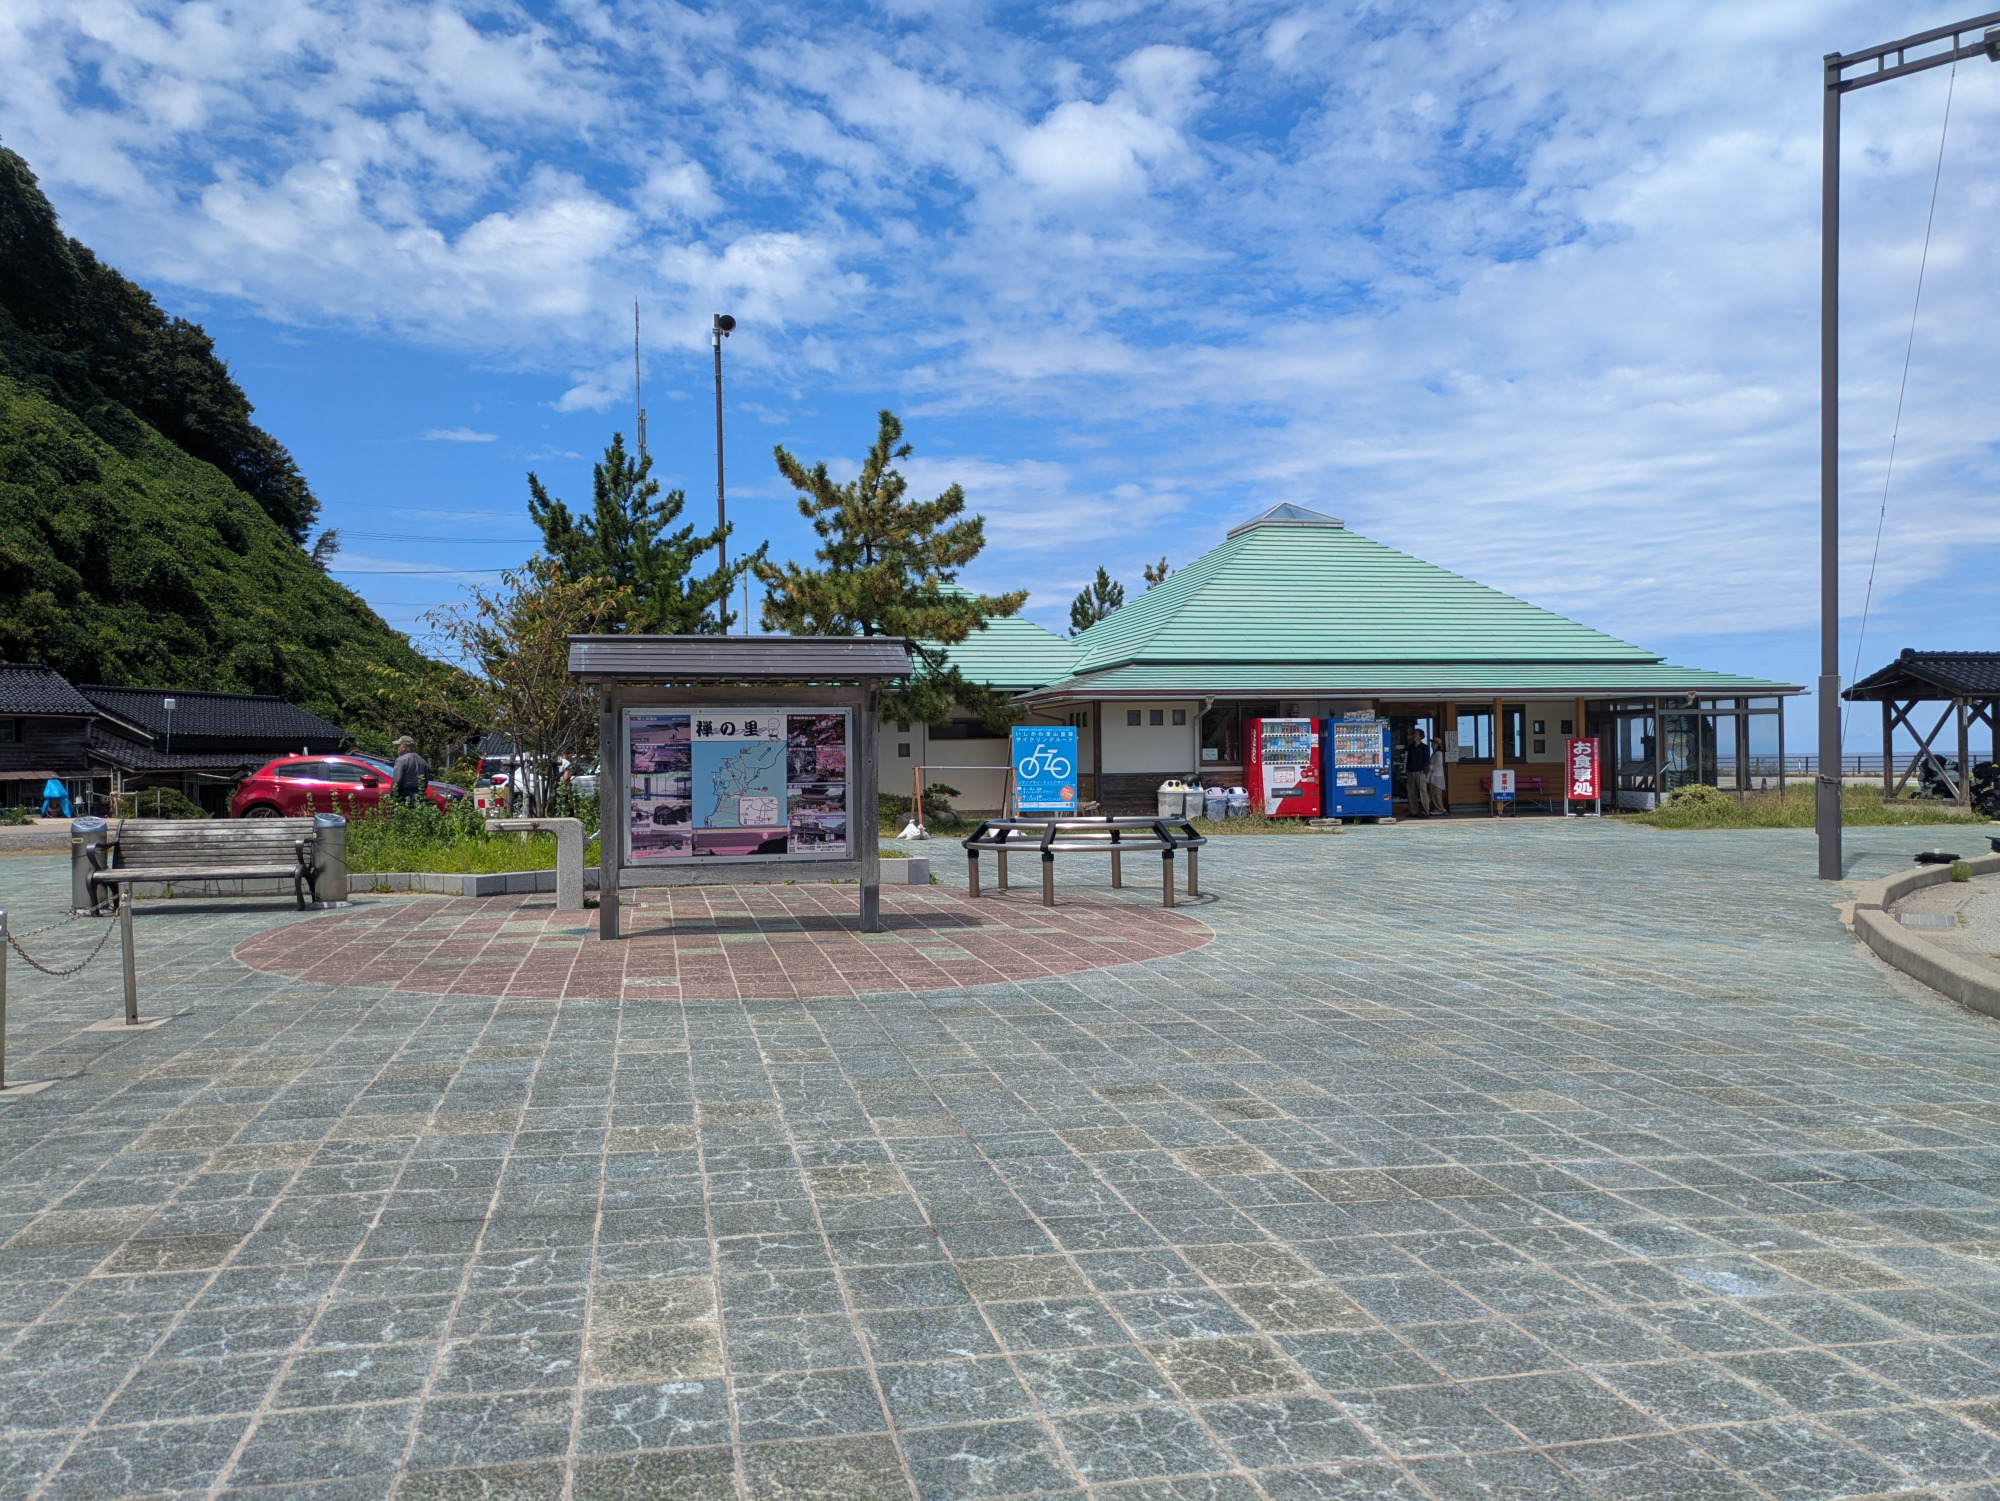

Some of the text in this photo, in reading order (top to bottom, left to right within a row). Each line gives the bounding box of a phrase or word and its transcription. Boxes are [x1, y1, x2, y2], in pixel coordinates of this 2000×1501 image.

[696, 720, 760, 737] 禅の里
[1573, 741, 1592, 796] お食事処
